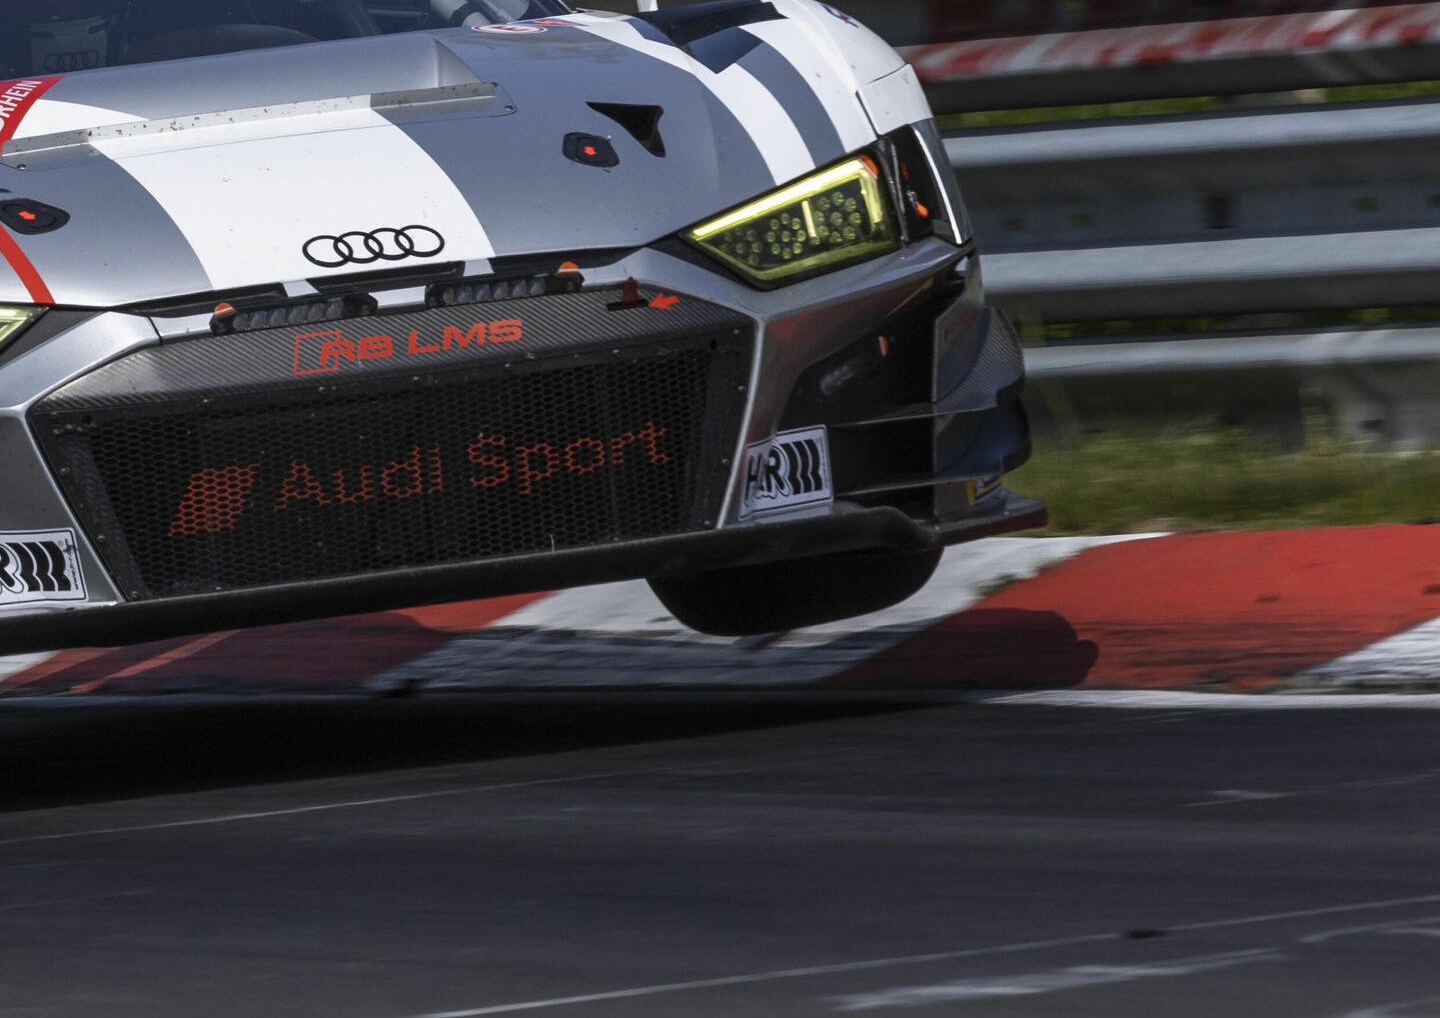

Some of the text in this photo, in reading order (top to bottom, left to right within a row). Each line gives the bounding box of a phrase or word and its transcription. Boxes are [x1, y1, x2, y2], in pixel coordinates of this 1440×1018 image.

[312, 318, 524, 367] R8 LMS
[274, 420, 671, 512] Audi Sport
